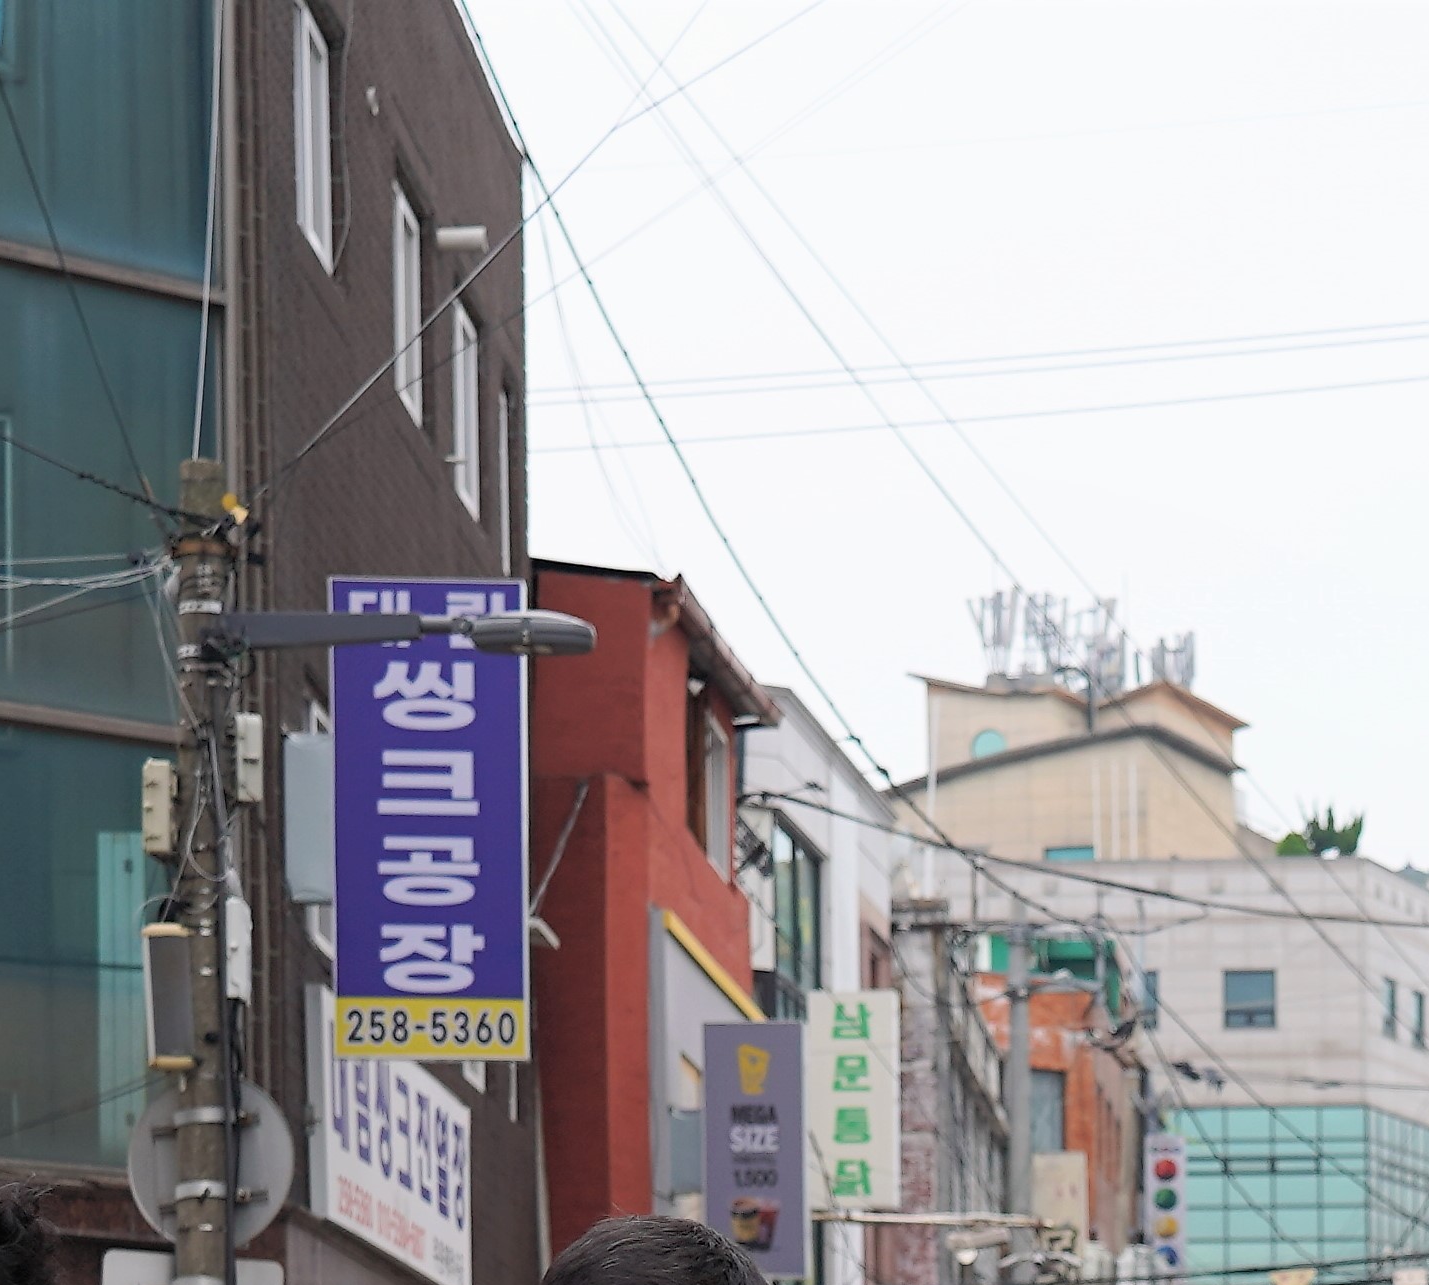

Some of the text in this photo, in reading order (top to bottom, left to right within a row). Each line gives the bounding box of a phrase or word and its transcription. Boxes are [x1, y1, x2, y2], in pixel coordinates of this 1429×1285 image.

[373, 660, 485, 994] 씽크공장
[347, 1010, 516, 1045] 258-5360
[729, 1125, 780, 1153] SIZE
